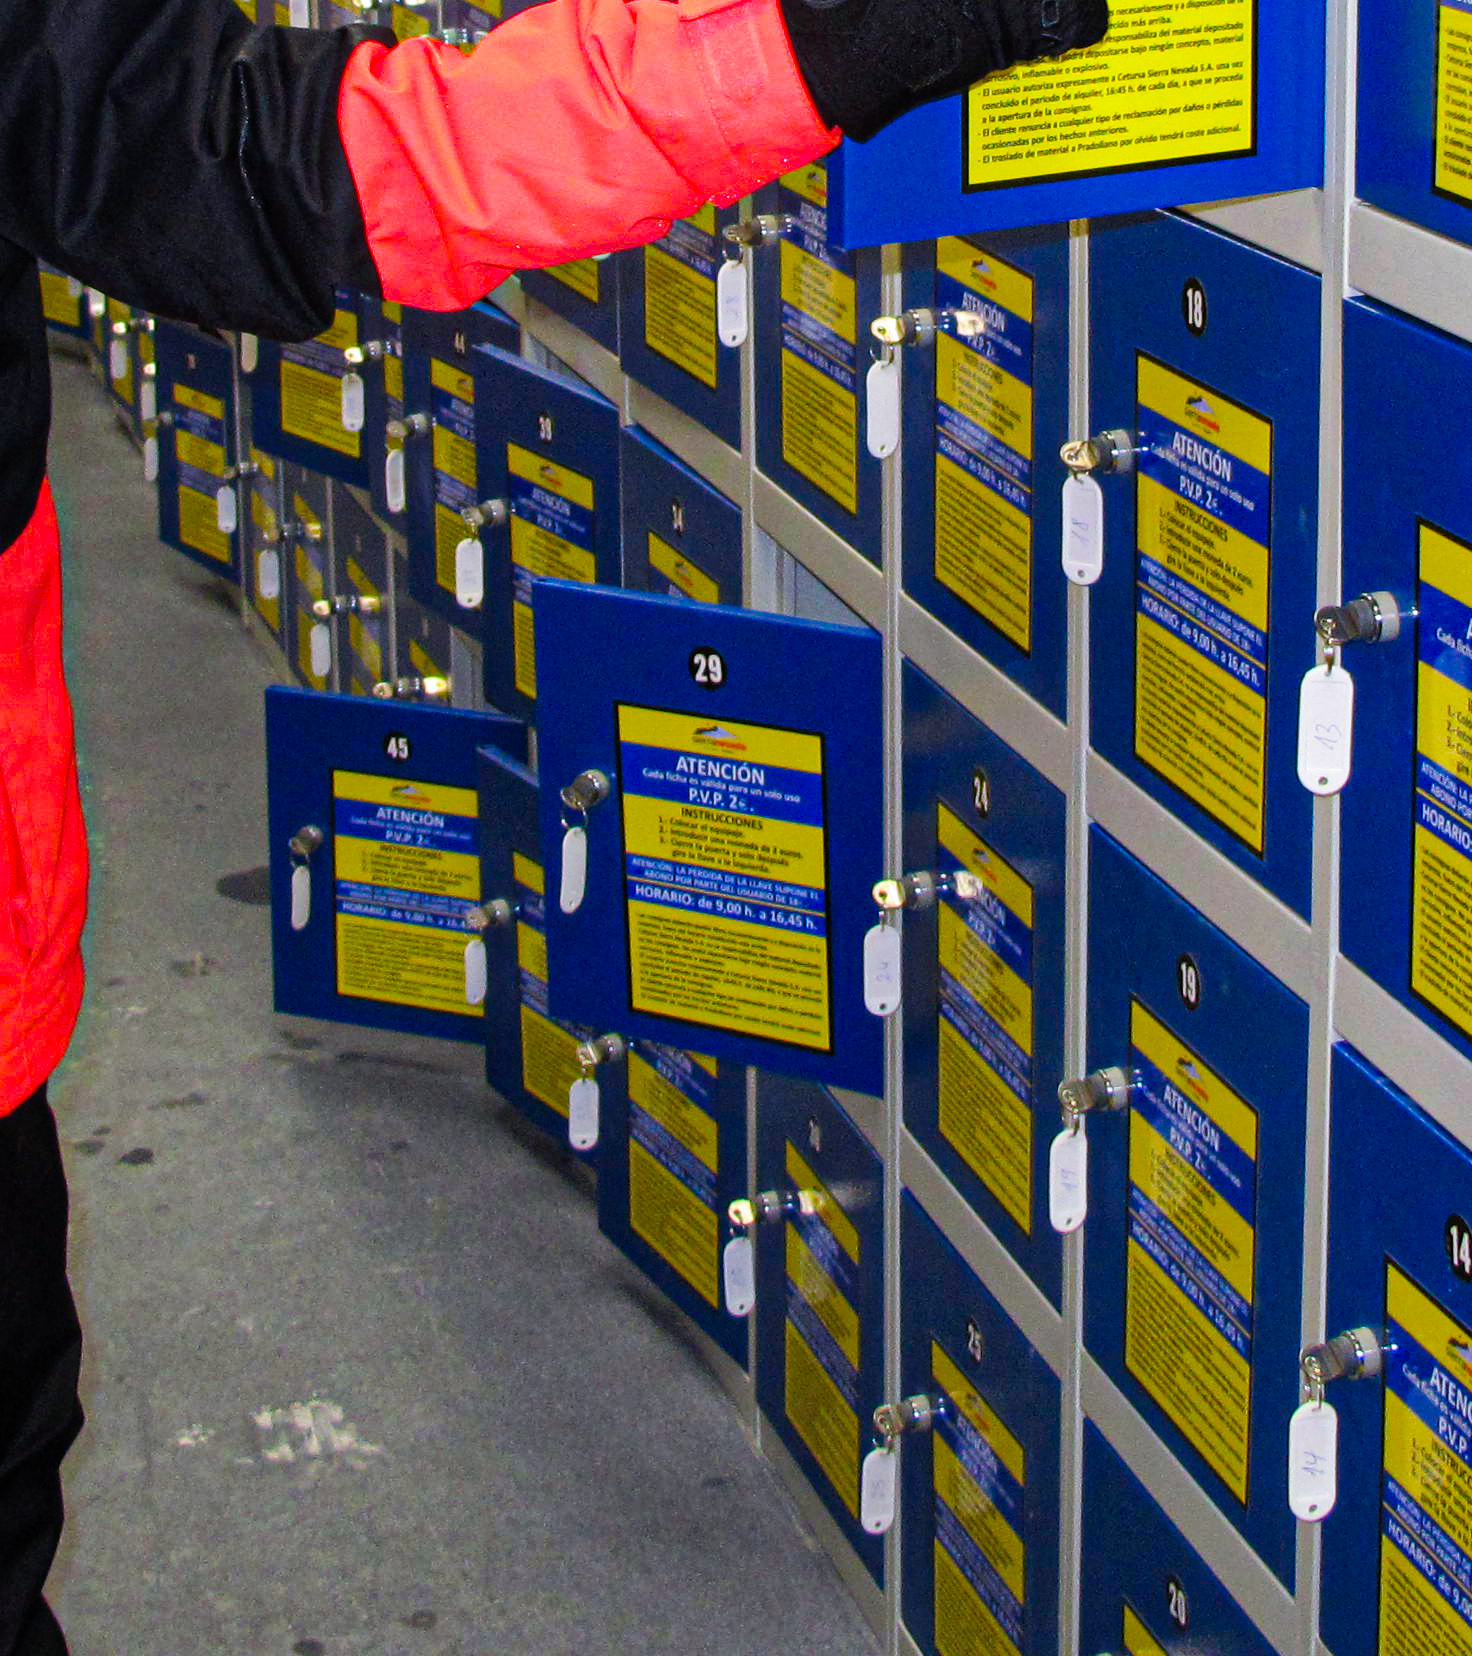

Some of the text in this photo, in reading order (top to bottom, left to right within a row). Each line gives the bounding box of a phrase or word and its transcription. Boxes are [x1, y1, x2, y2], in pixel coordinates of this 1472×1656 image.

[1187, 289, 1202, 327] 18
[1173, 431, 1231, 483] ATENCIÓN
[694, 654, 722, 682] 29
[388, 738, 408, 758] 45
[1313, 724, 1343, 750] 13
[676, 756, 765, 786] ATENCIÓN
[974, 778, 987, 811] 24
[636, 884, 695, 907] HORARIO:
[1181, 963, 1196, 1002] 19
[1449, 1224, 1471, 1274] 14
[1301, 1450, 1328, 1477] 14
[1169, 1584, 1185, 1625] 20
